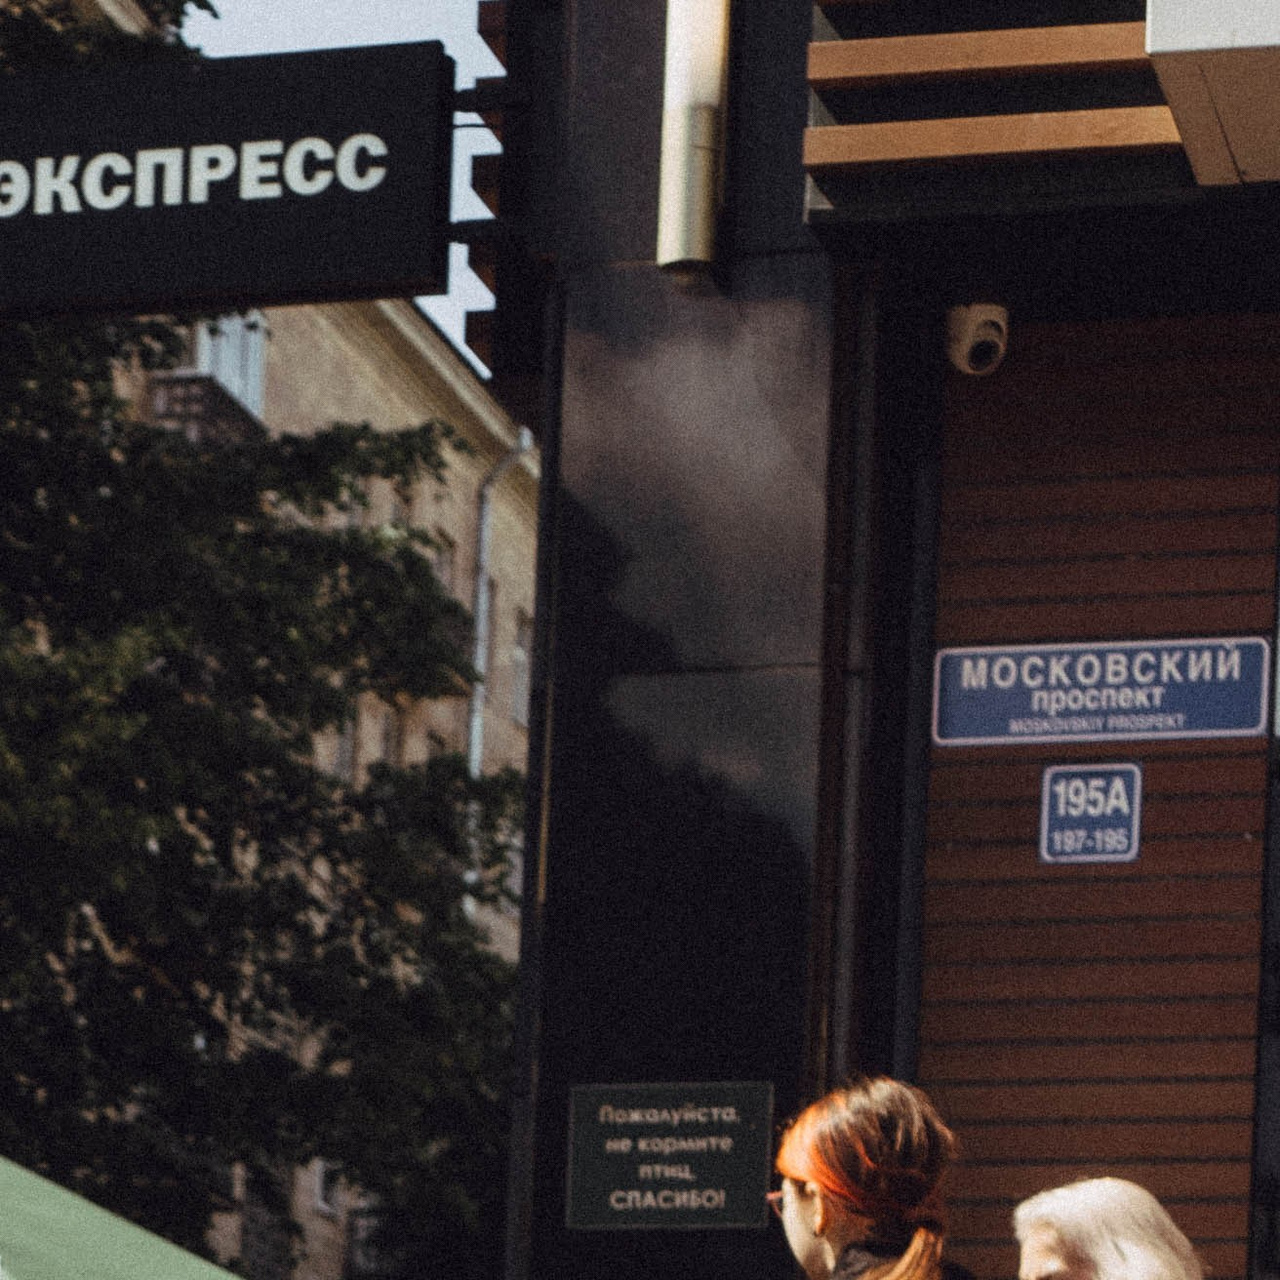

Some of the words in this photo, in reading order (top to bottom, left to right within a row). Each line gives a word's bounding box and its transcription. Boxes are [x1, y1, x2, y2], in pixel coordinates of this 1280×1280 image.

[961, 642, 1242, 690] МОСКОВСКИЙ
[1031, 686, 1166, 715] проспект
[609, 1188, 726, 1210] СПАСИБО!
